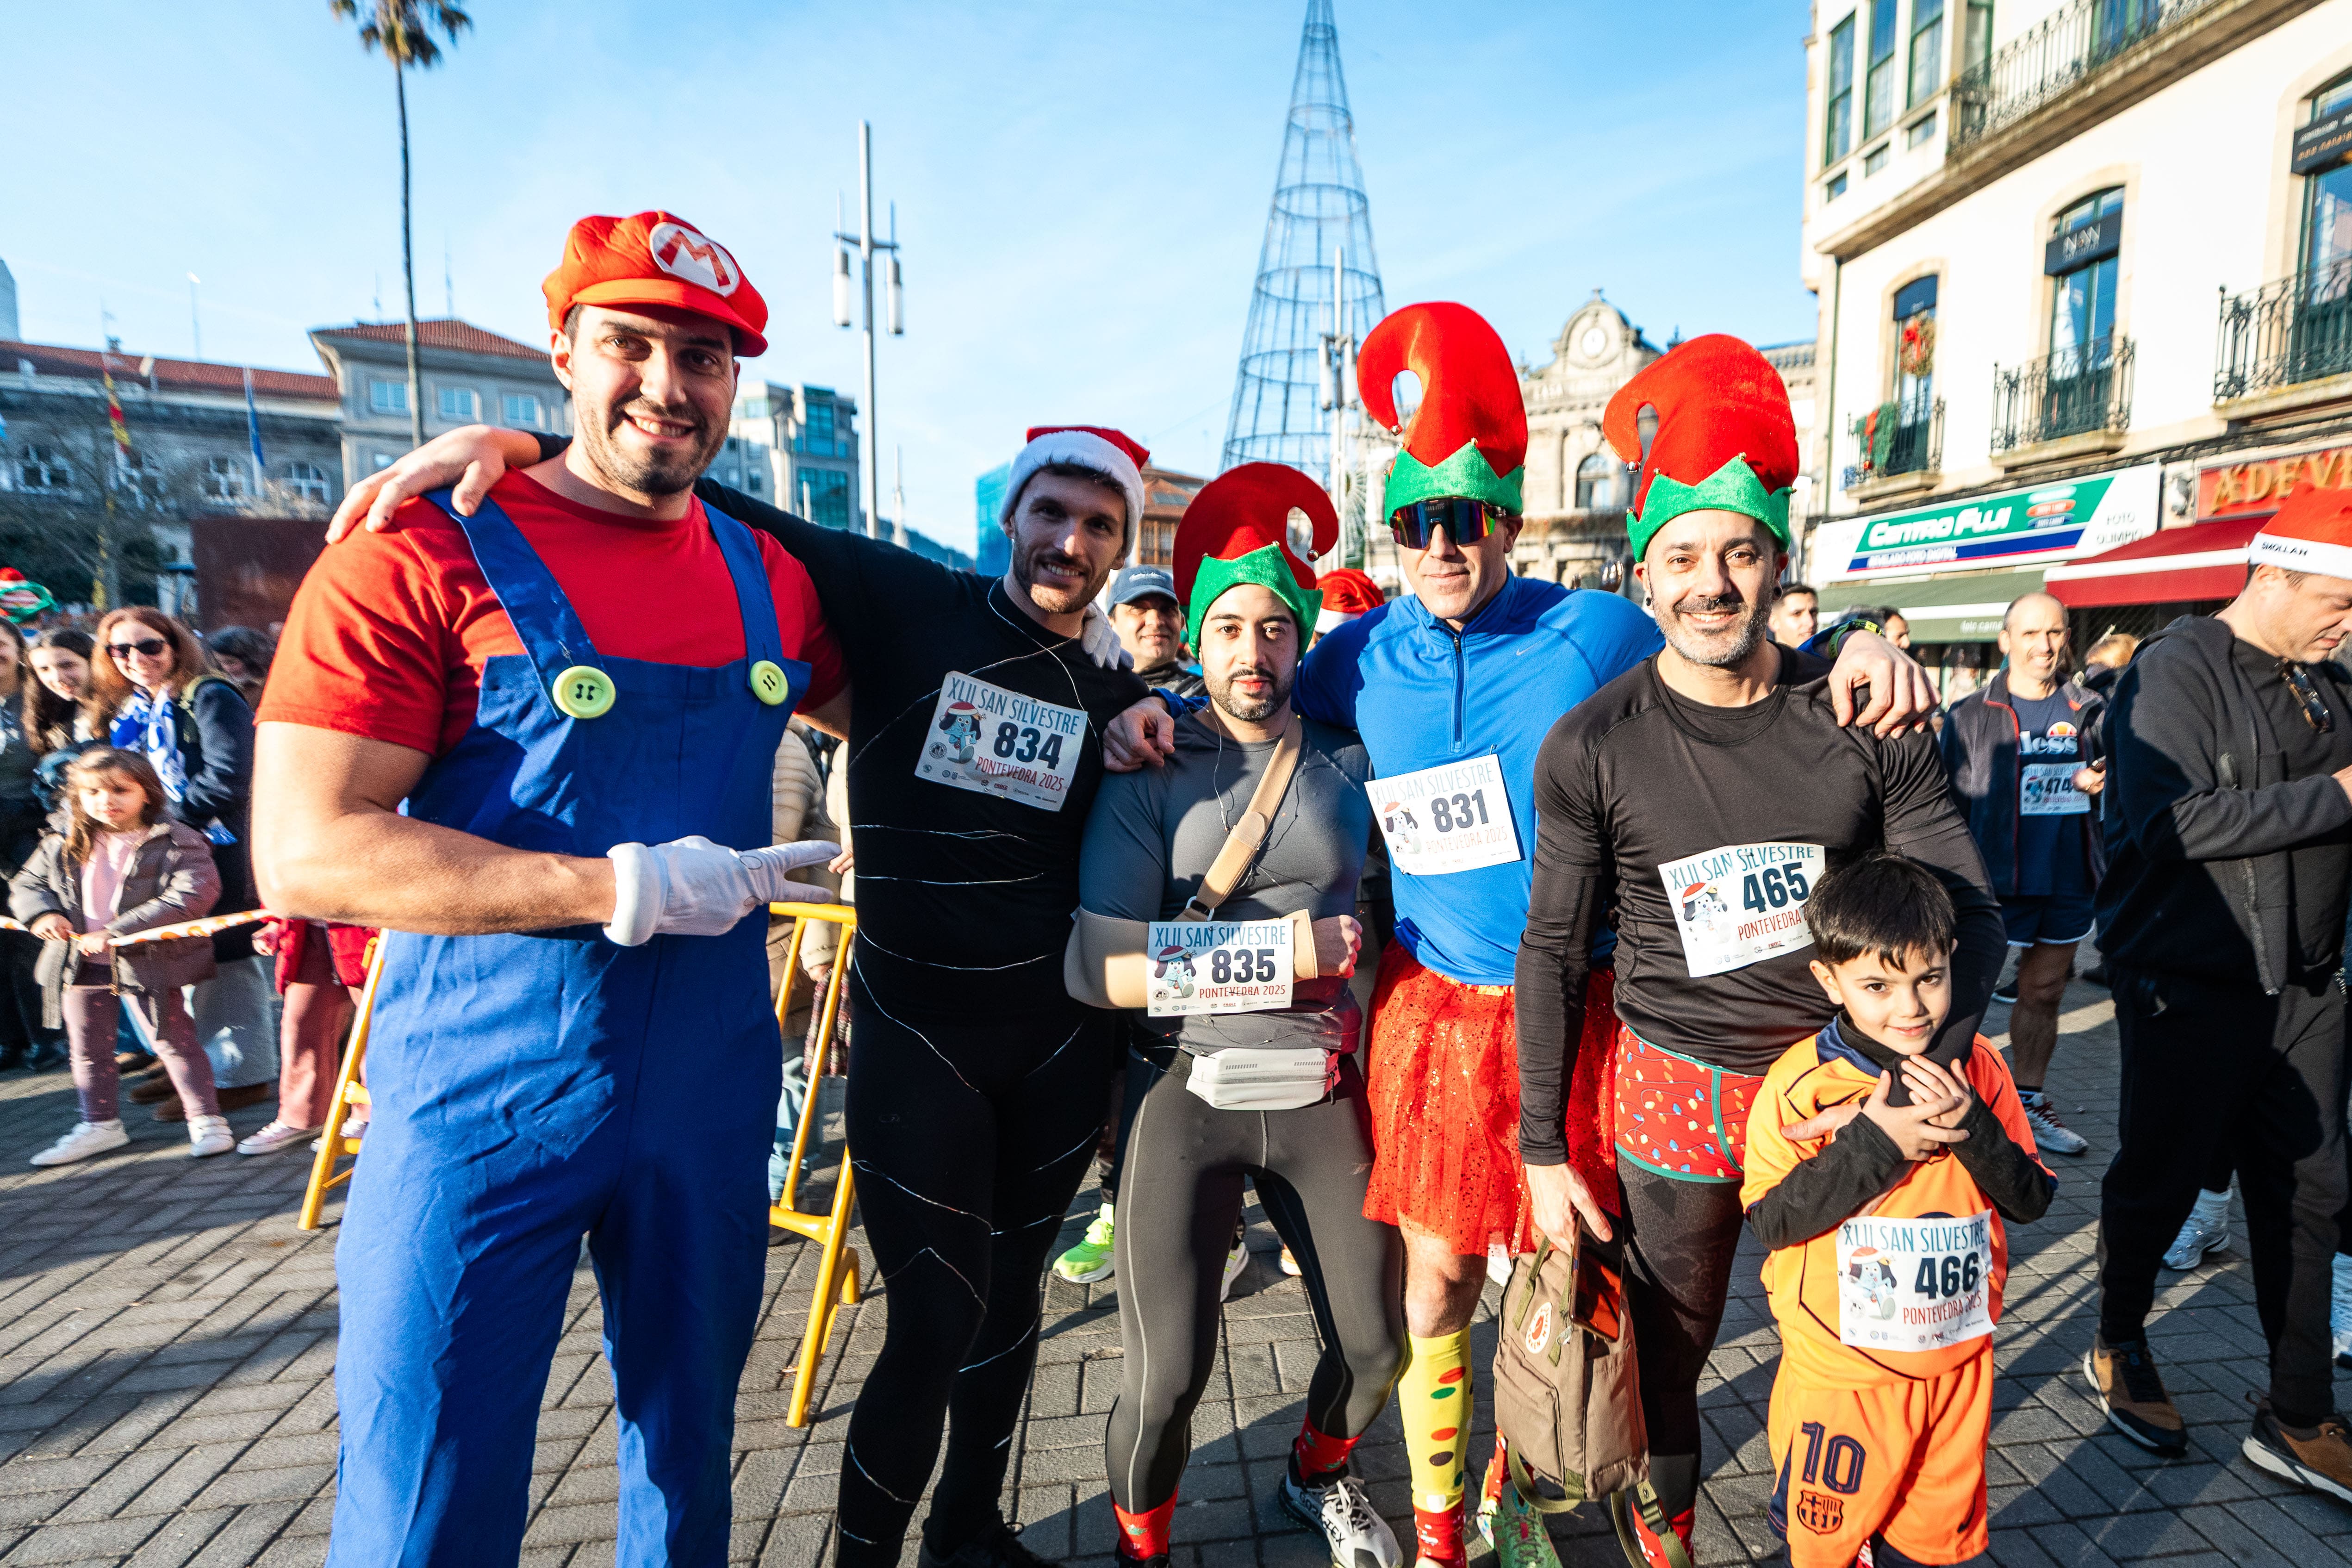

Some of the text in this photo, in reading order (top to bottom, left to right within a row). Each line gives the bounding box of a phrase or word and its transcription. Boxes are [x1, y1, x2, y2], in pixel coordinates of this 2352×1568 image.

[656, 229, 731, 287] M
[2107, 512, 2135, 525] FOTO
[2262, 541, 2308, 556] SMOLLAN
[1960, 620, 2003, 633] foto carne
[977, 688, 1008, 716] SAN
[1009, 699, 1080, 735] SILVESTRE
[993, 721, 1064, 770] 834
[975, 756, 1064, 791] PONTEVEDRA 2025
[1398, 777, 1425, 801] SAN
[1427, 763, 1494, 795] SILVESTRE
[2045, 777, 2073, 795] 474
[1431, 789, 1489, 832] 831
[1425, 826, 1508, 853] PONTEVEDRA 2025
[1702, 853, 1734, 880] SAN
[1736, 846, 1815, 871] SILVESTRE
[1743, 862, 1809, 913] 465
[1186, 927, 1213, 947] SAN
[1218, 926, 1286, 945] SILVESTRE
[1738, 909, 1802, 940] PONTEVEDRA
[1212, 949, 1276, 983] 835
[1200, 985, 1285, 998] PONTEVEDRA 2025
[1880, 1226, 1915, 1252] SAN
[1921, 1219, 1986, 1252] SILVESTRE
[1915, 1251, 1979, 1300] 466
[1904, 1290, 1982, 1325] PONTEVEDRA 2025
[1801, 1421, 1867, 1494] 10
